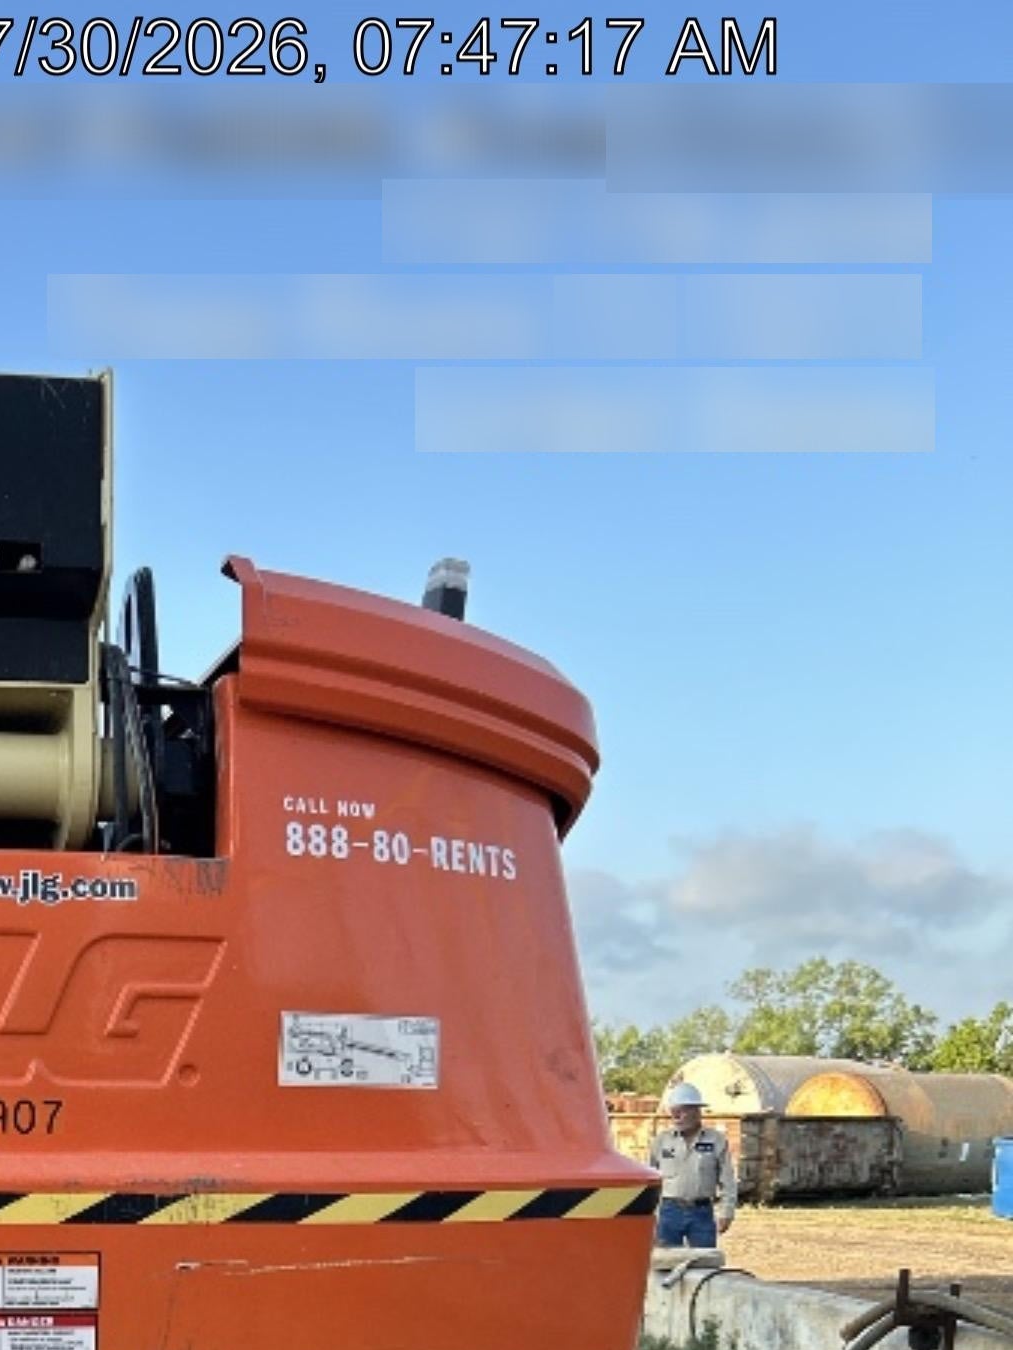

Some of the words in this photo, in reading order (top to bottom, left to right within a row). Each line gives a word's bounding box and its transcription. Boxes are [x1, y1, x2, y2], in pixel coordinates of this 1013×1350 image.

[283, 796, 328, 814] CALL
[338, 800, 375, 819] NOW
[286, 821, 517, 880] 888-80-RENTS
